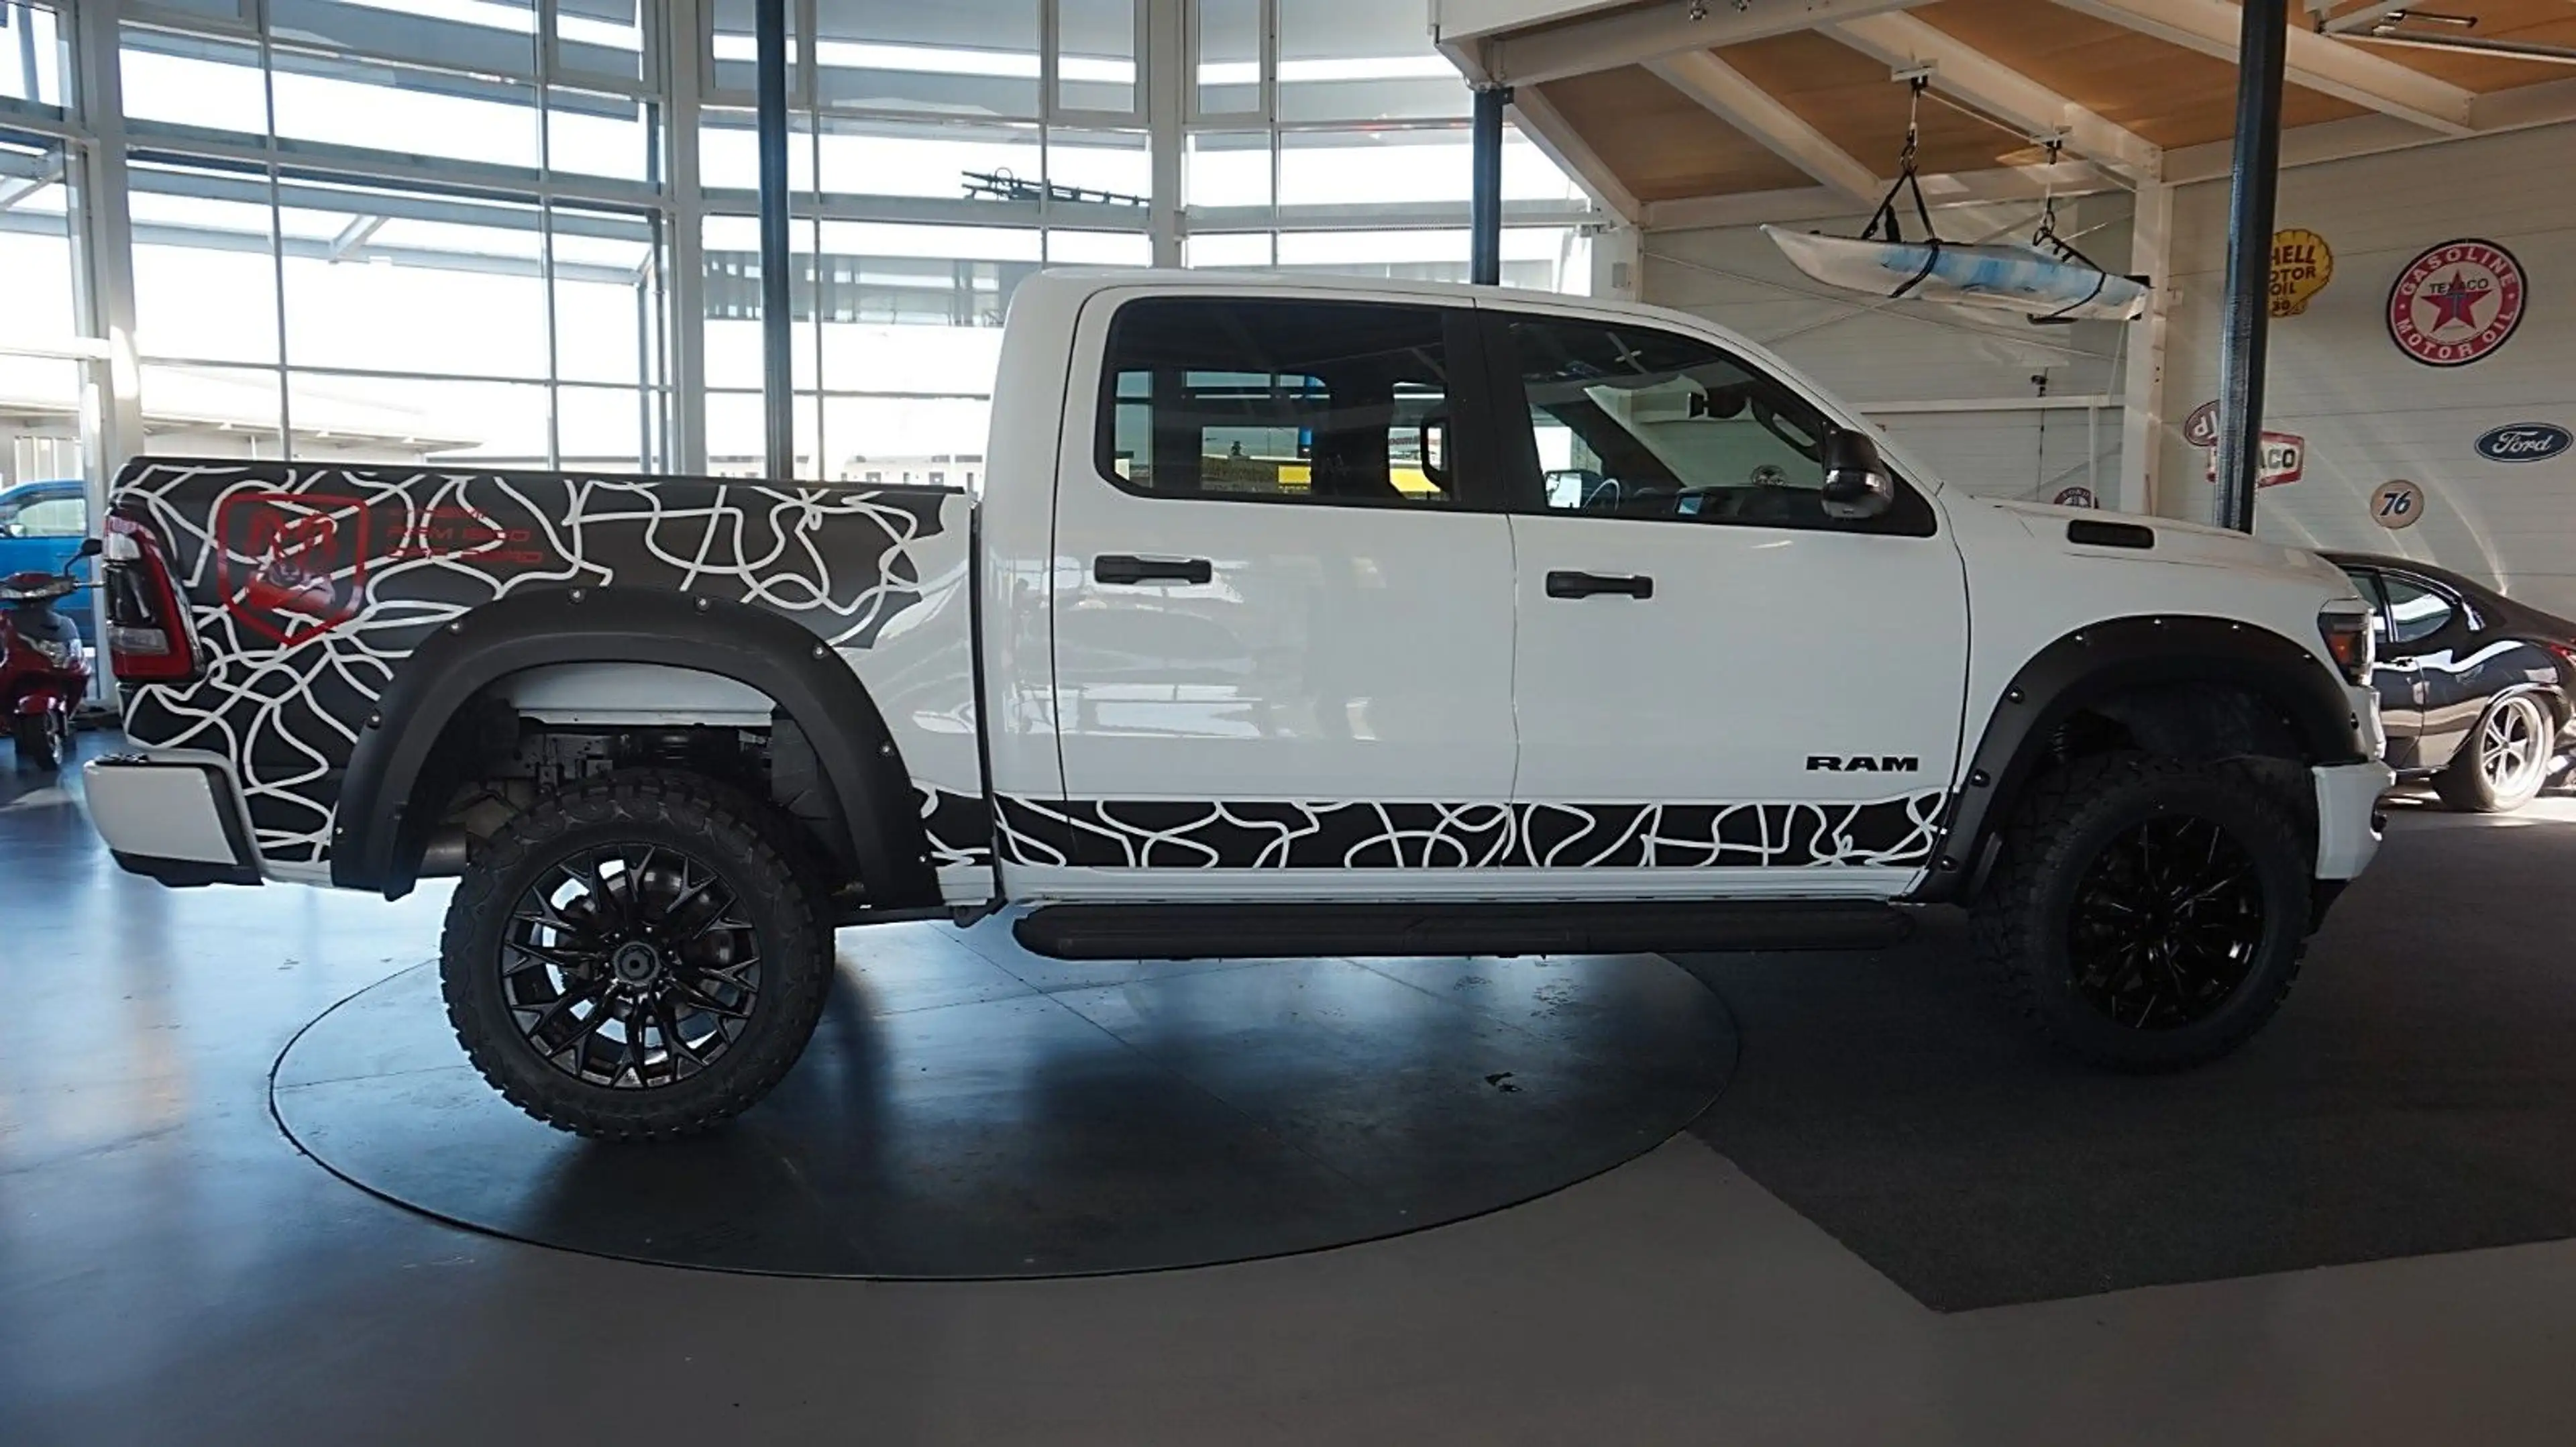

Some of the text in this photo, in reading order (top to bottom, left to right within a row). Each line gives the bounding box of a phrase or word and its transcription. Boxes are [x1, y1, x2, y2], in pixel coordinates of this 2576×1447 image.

[2271, 245, 2316, 265] HELL
[2269, 266, 2316, 282] OTOR
[2400, 246, 2516, 295] GASOLINE
[2270, 282, 2297, 296] OIL
[2397, 311, 2515, 359] MOTOR OIL
[2492, 431, 2553, 453] Ford
[2379, 490, 2412, 516] 76
[1806, 755, 1919, 771] RAM
